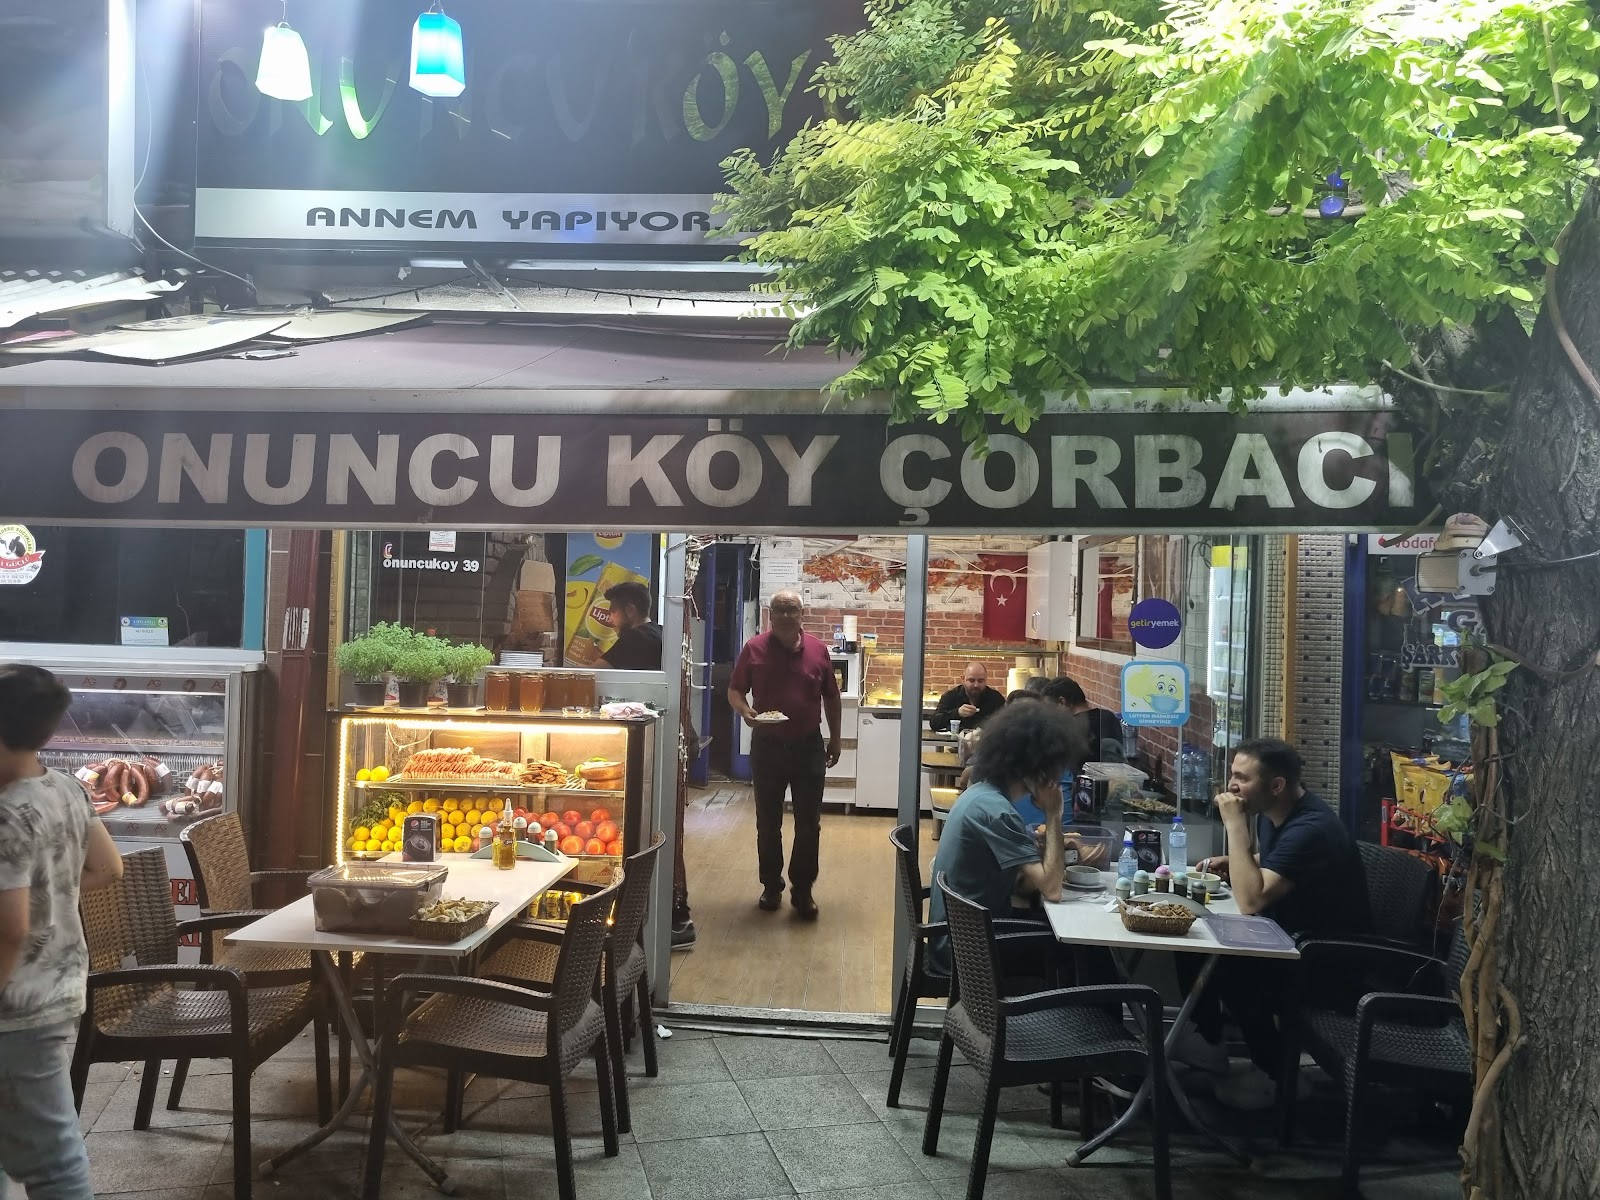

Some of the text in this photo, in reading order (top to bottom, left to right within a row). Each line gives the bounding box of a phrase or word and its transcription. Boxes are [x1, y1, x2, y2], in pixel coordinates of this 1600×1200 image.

[306, 206, 478, 231] ANNEM
[71, 418, 1415, 526] ONUNCU KÖY ÇORBACI
[462, 559, 480, 573] 39
[1130, 619, 1179, 629] getiryemek
